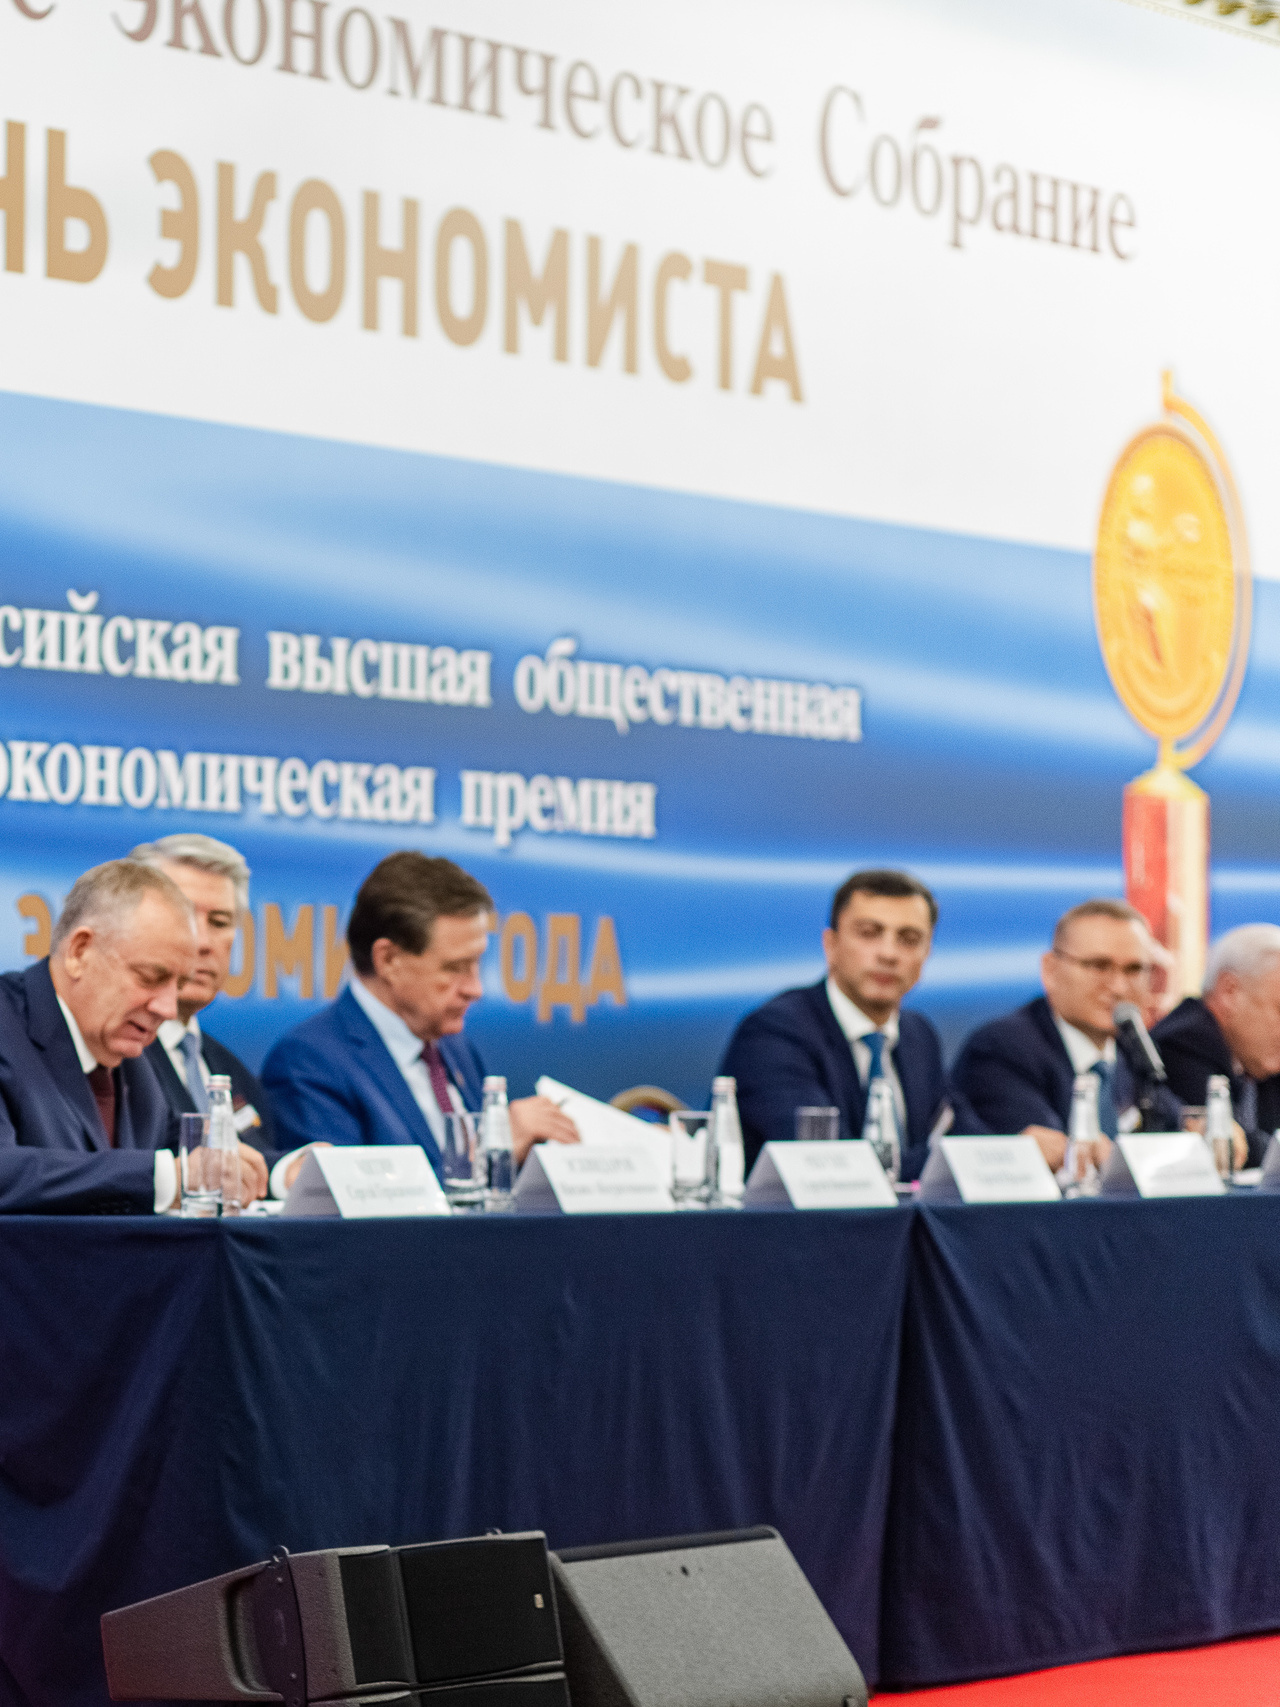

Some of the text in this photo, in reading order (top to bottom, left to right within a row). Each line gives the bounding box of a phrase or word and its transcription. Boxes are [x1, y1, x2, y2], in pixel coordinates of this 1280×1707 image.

[817, 84, 1137, 261] Собрание
[146, 148, 805, 404] ЭКОНОМИСТА
[266, 630, 492, 708] высшая
[512, 635, 862, 743] общественная
[460, 767, 658, 848] премия
[486, 911, 628, 1023] ОДА
